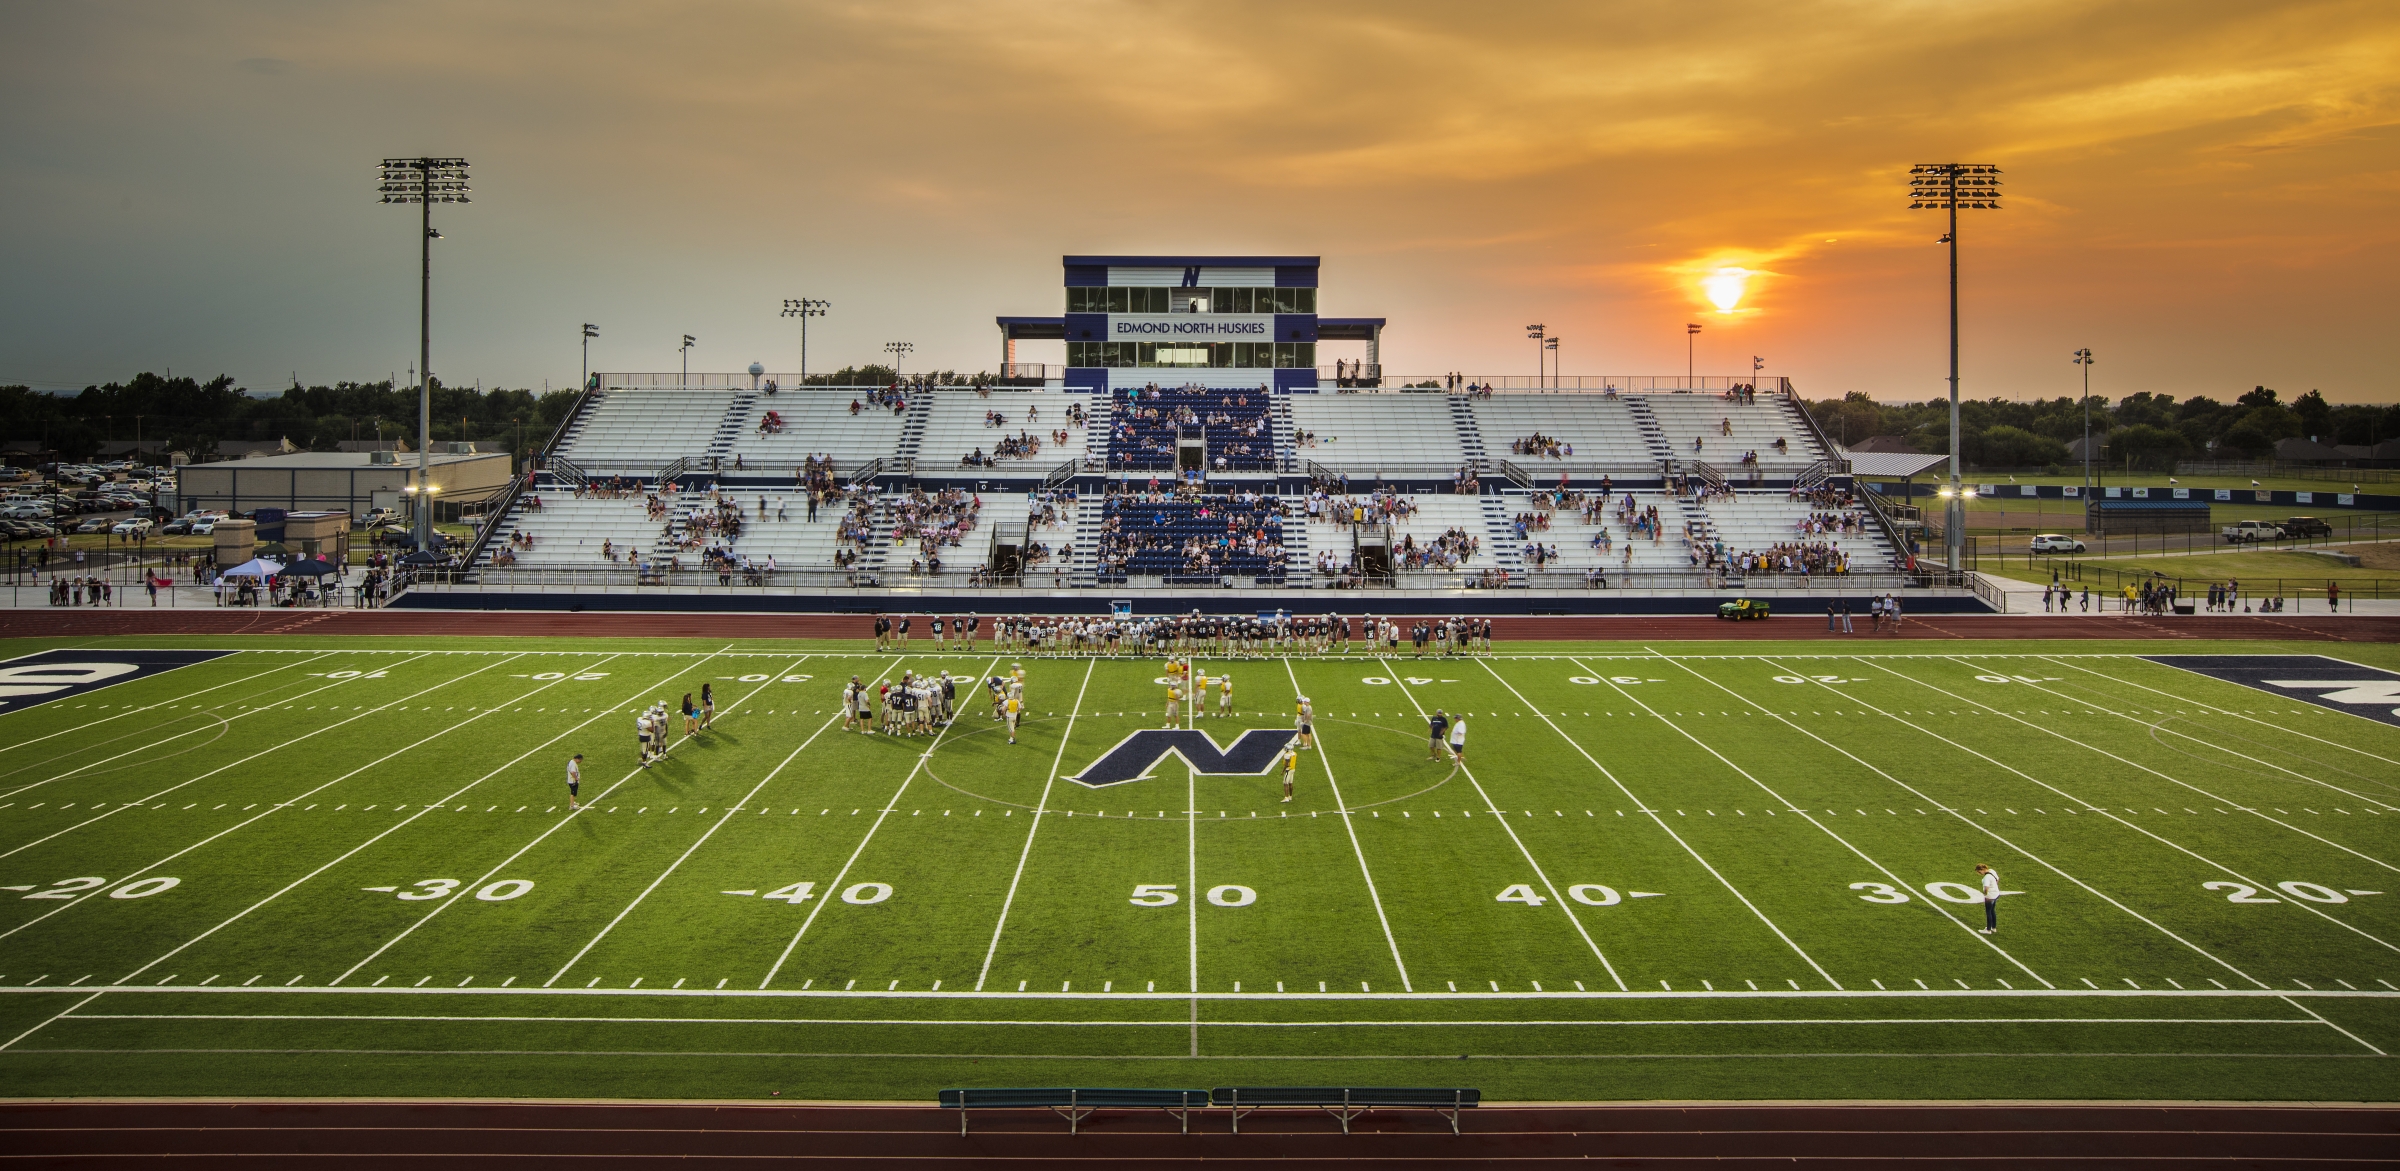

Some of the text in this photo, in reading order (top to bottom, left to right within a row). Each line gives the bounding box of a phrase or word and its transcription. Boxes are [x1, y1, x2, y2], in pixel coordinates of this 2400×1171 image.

[1181, 265, 1201, 287] N
[1117, 322, 1265, 334] EDMOND NORTH HUSKIES
[532, 672, 610, 681] 20
[737, 674, 813, 683] 30
[1362, 677, 1433, 686] 40
[1569, 677, 1642, 685] 30
[1772, 675, 1848, 684] 20
[905, 698, 914, 707] 31
[1060, 729, 1298, 789] N
[22, 877, 180, 899] 20
[397, 879, 534, 901] 30
[763, 882, 892, 904] 40
[1129, 885, 1256, 907] 50
[1496, 885, 1621, 906] 40
[1849, 882, 1986, 904] 30
[2202, 881, 2348, 904] 20
